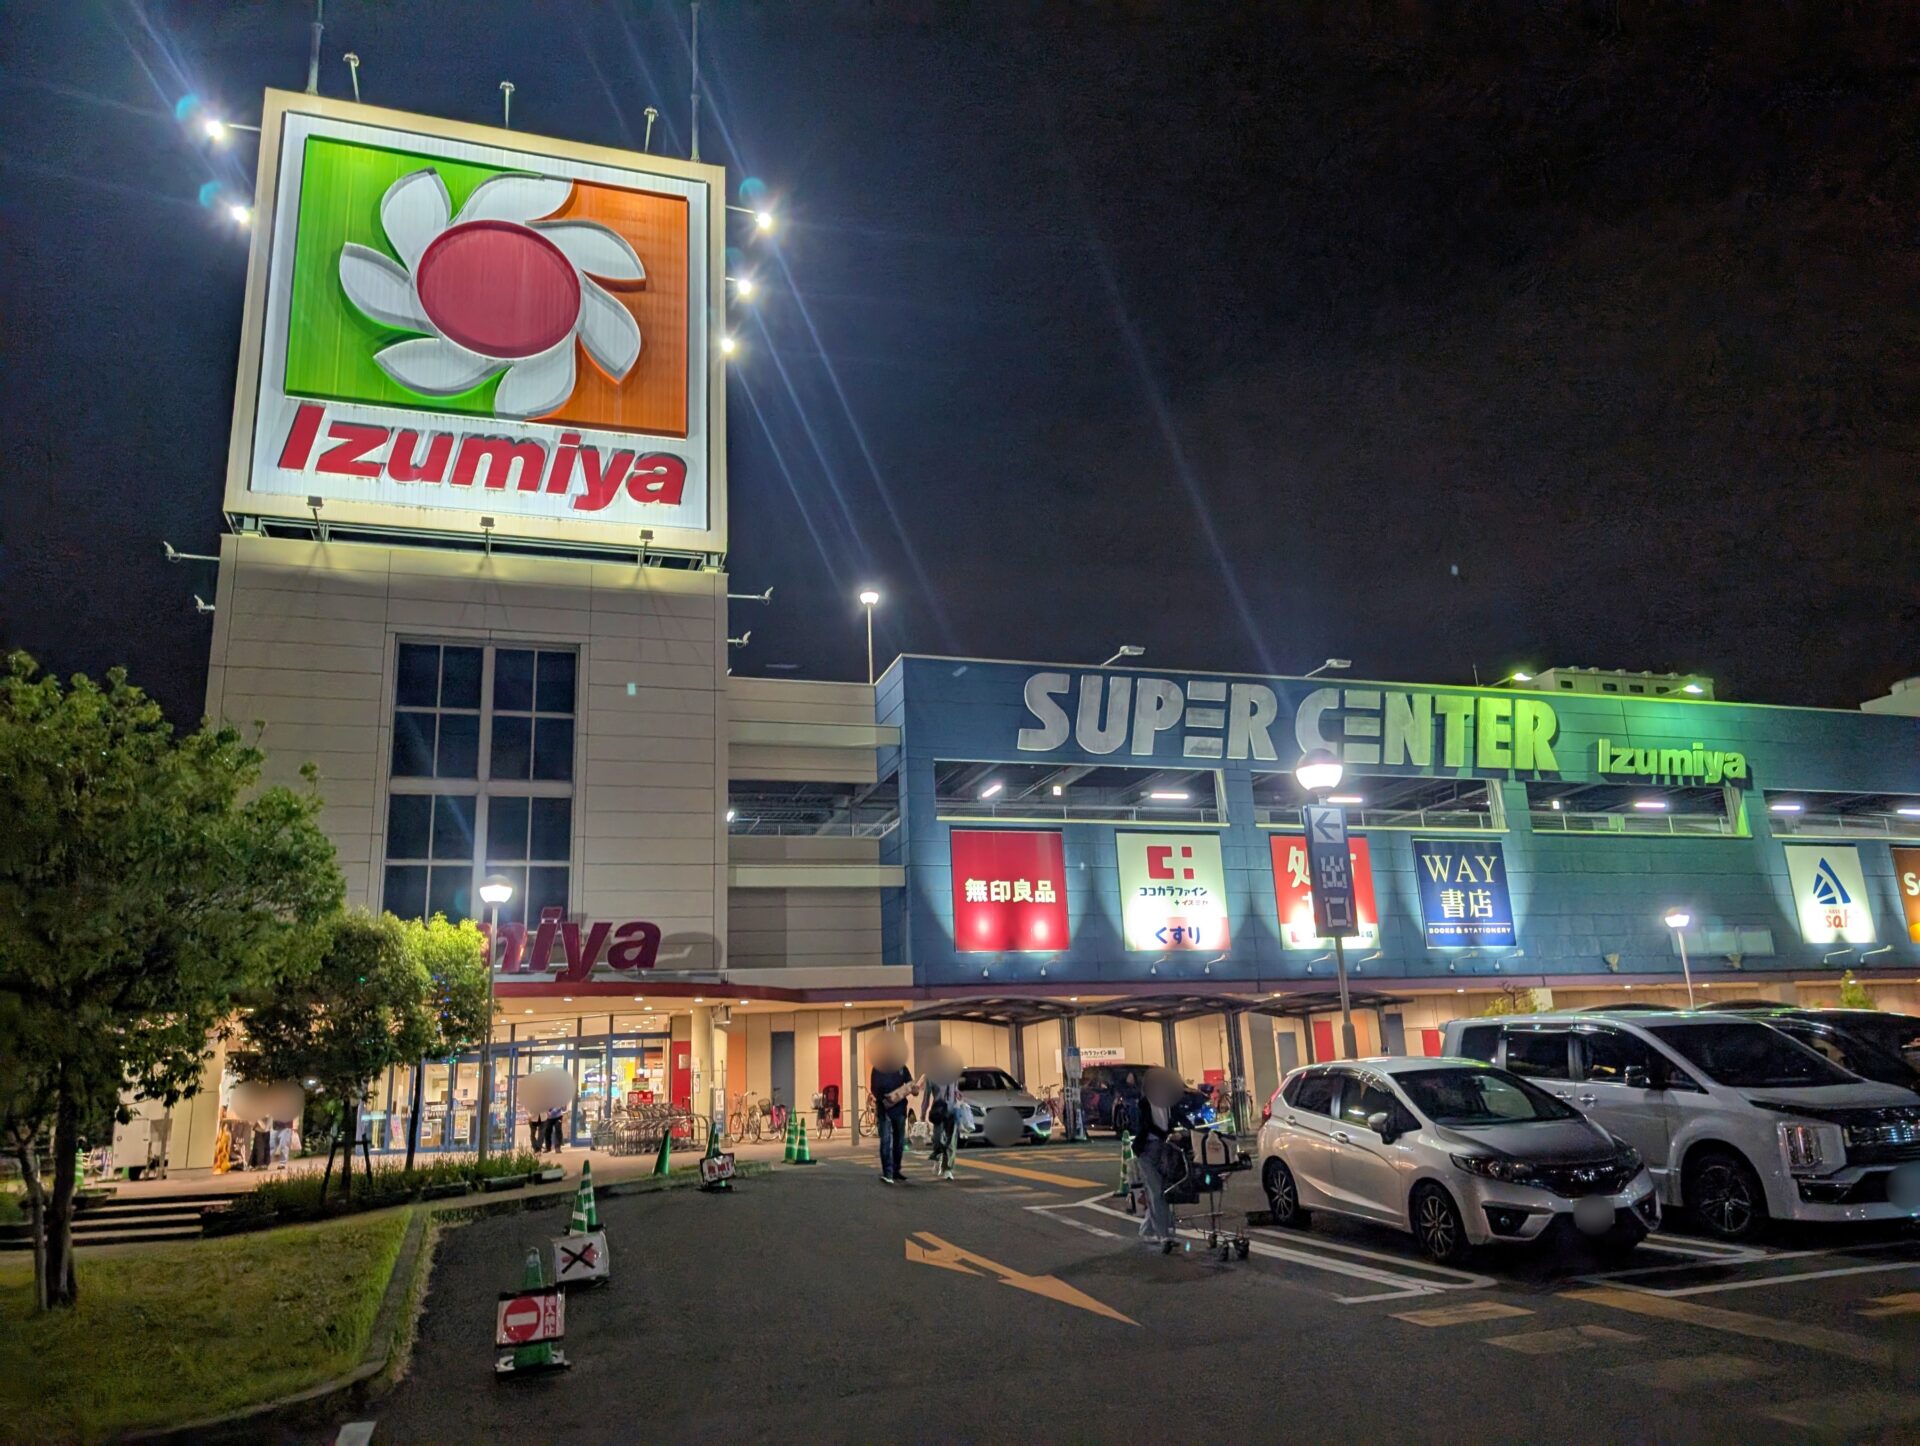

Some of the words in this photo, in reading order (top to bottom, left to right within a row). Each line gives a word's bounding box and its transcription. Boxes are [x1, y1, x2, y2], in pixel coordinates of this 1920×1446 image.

[277, 403, 689, 512] Izumiya
[1016, 671, 1279, 761] SUPER
[1295, 688, 1559, 771] CENTER
[1597, 737, 1748, 785] Izumiya
[1421, 854, 1498, 883] WAY
[965, 878, 1056, 904] 無印良品
[1139, 886, 1207, 896] ココカラファイン
[1320, 855, 1353, 929] 出口
[1903, 871, 1920, 896] S
[1440, 888, 1493, 918] 書店
[1155, 925, 1201, 945] くすり
